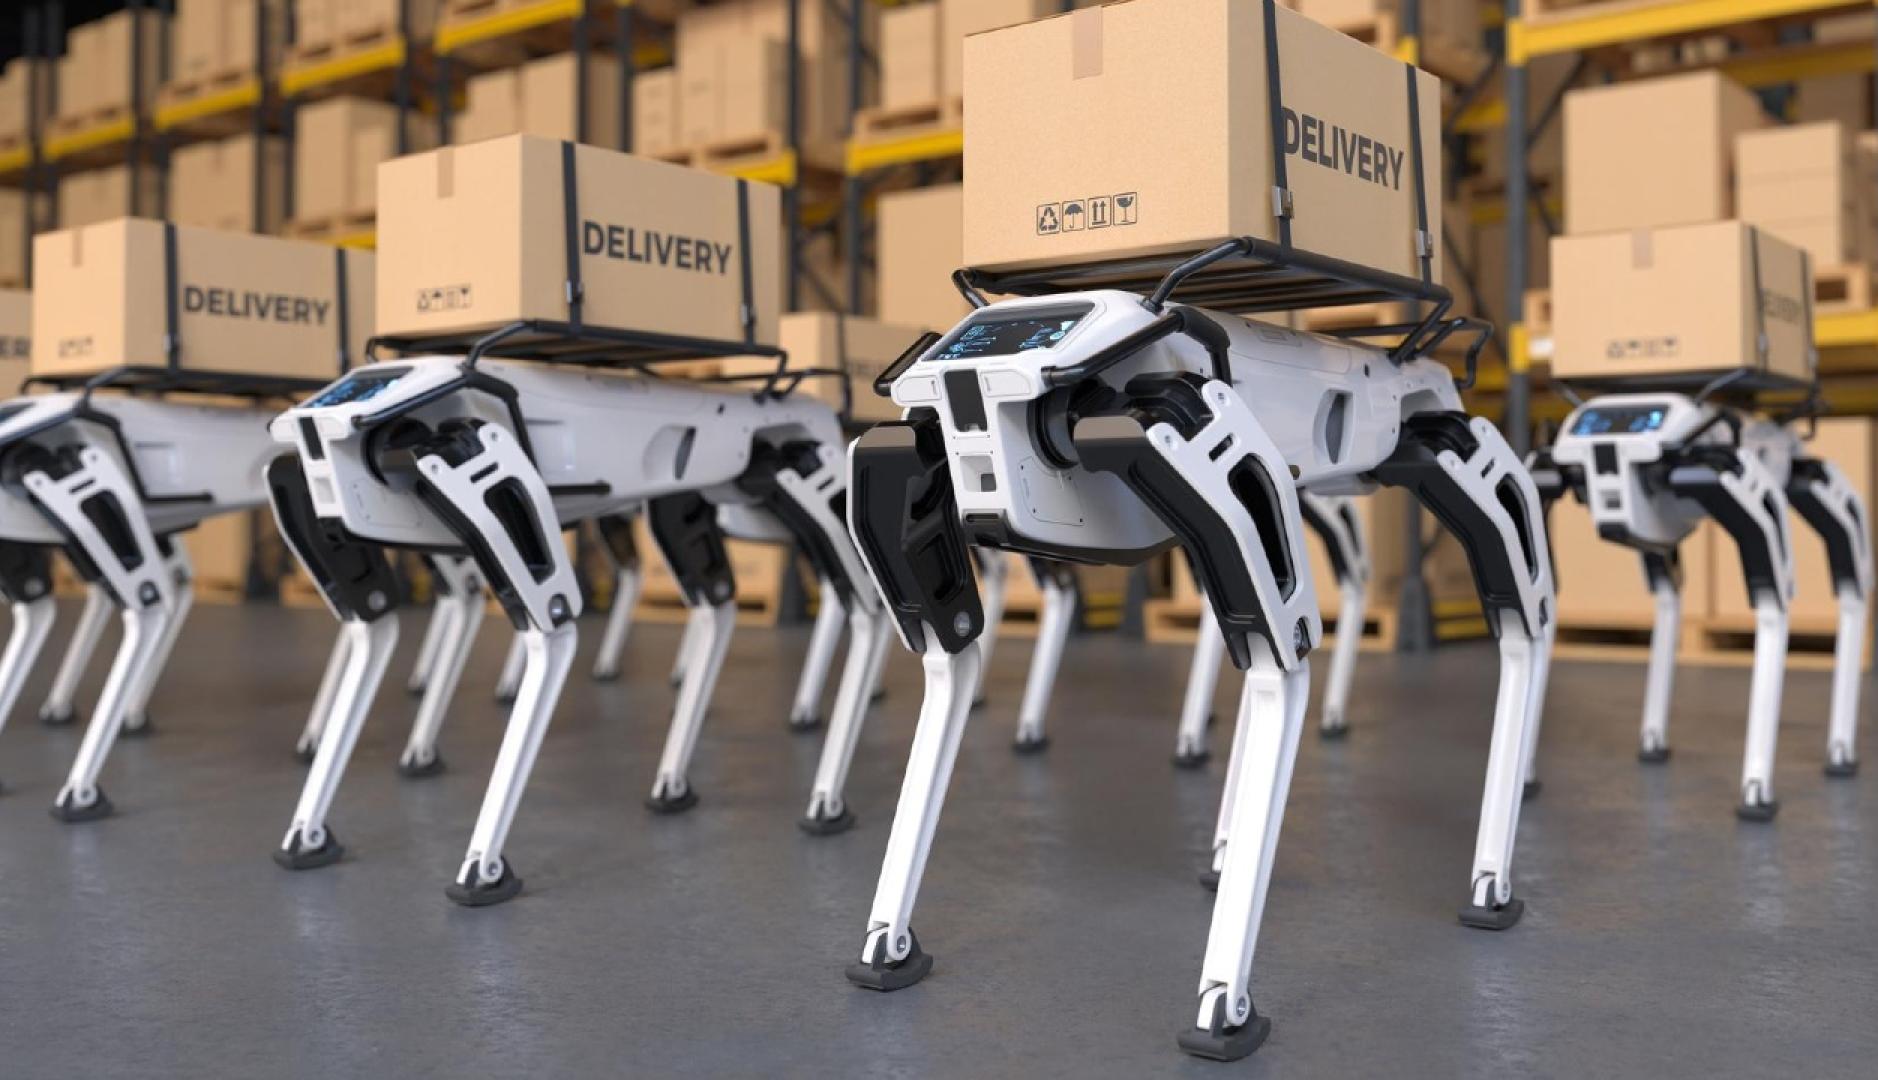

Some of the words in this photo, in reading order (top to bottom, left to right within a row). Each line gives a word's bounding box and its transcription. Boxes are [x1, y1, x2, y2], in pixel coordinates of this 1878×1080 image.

[1281, 106, 1403, 190] DELIVERY
[583, 220, 732, 275] DELIVERY
[183, 285, 330, 325] DELIVERY
